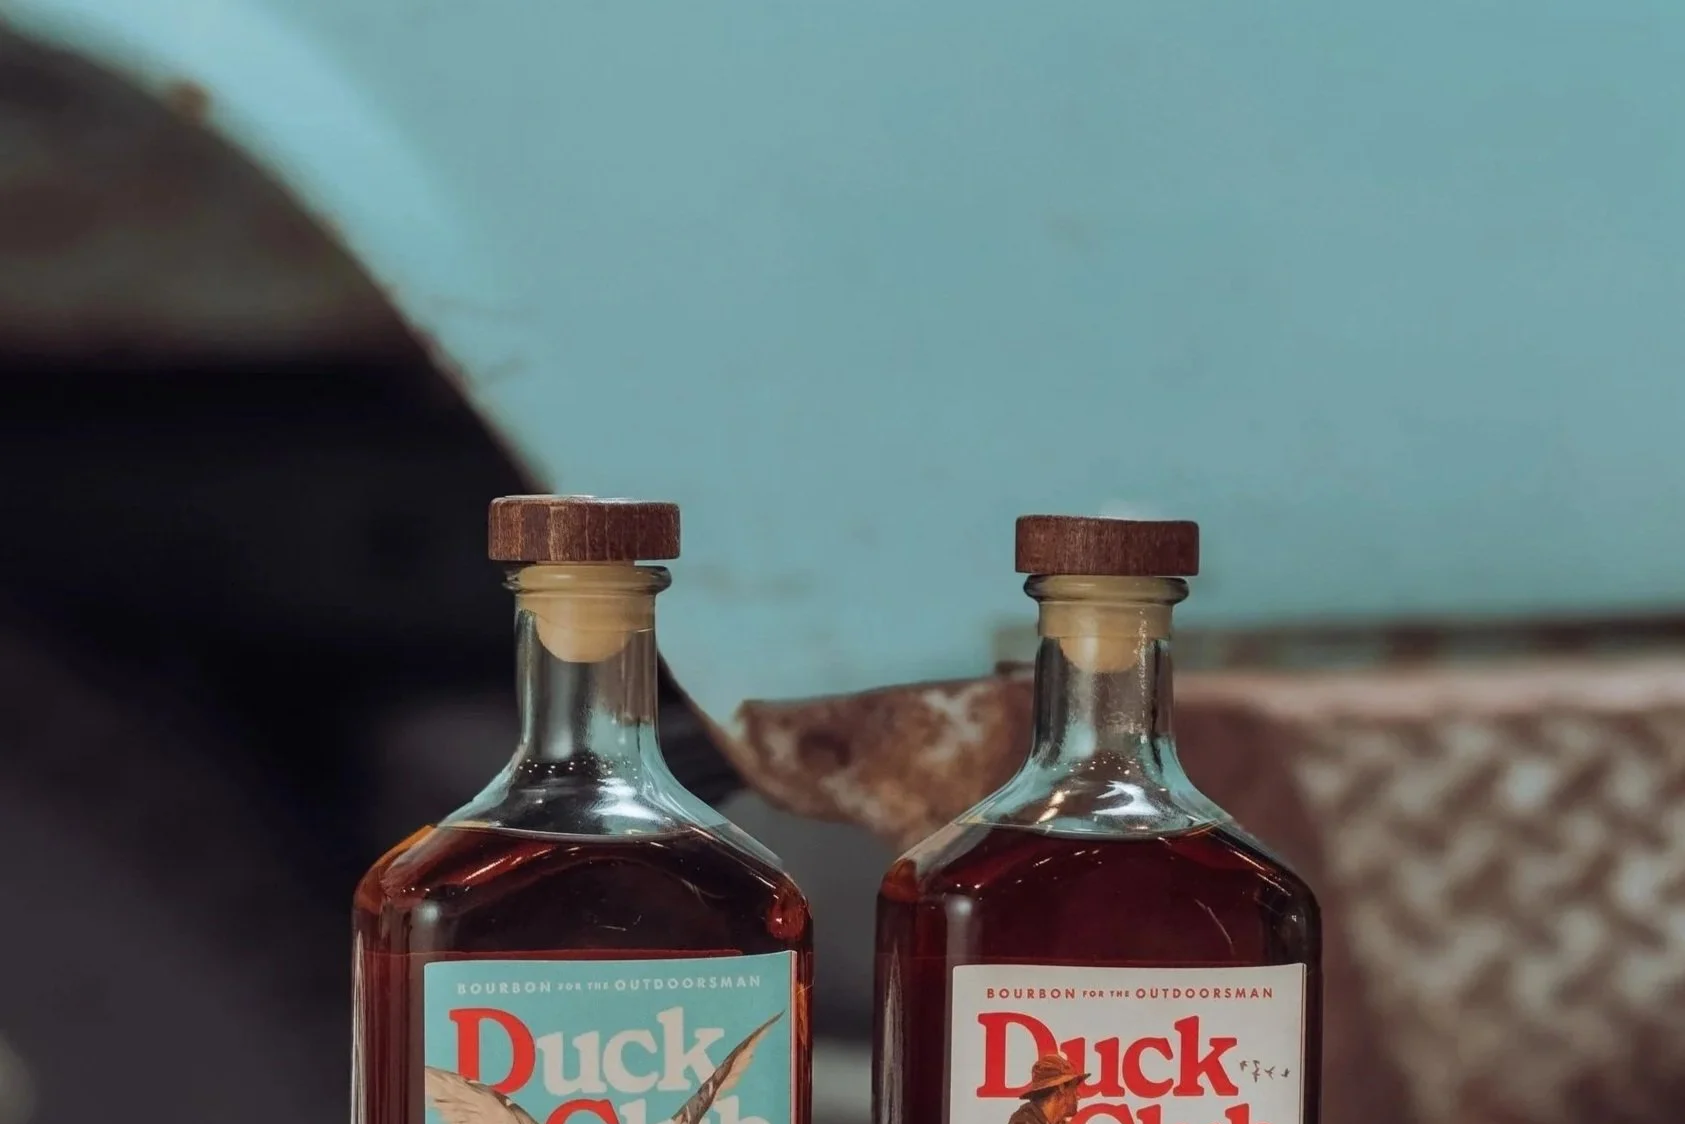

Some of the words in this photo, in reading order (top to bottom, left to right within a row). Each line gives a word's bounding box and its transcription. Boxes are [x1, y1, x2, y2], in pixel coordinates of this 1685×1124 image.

[457, 982, 551, 995] BOURBON
[559, 983, 581, 991] FOR
[588, 982, 608, 990] THE
[615, 975, 761, 991] OUTDOORSMAN
[987, 988, 1076, 999] BOURBON
[1083, 990, 1103, 998] FOR
[1110, 990, 1129, 998] THE
[1136, 988, 1273, 999] OUTDOORSMAN
[449, 1007, 725, 1095] Duck
[976, 1012, 1238, 1098] Duck
